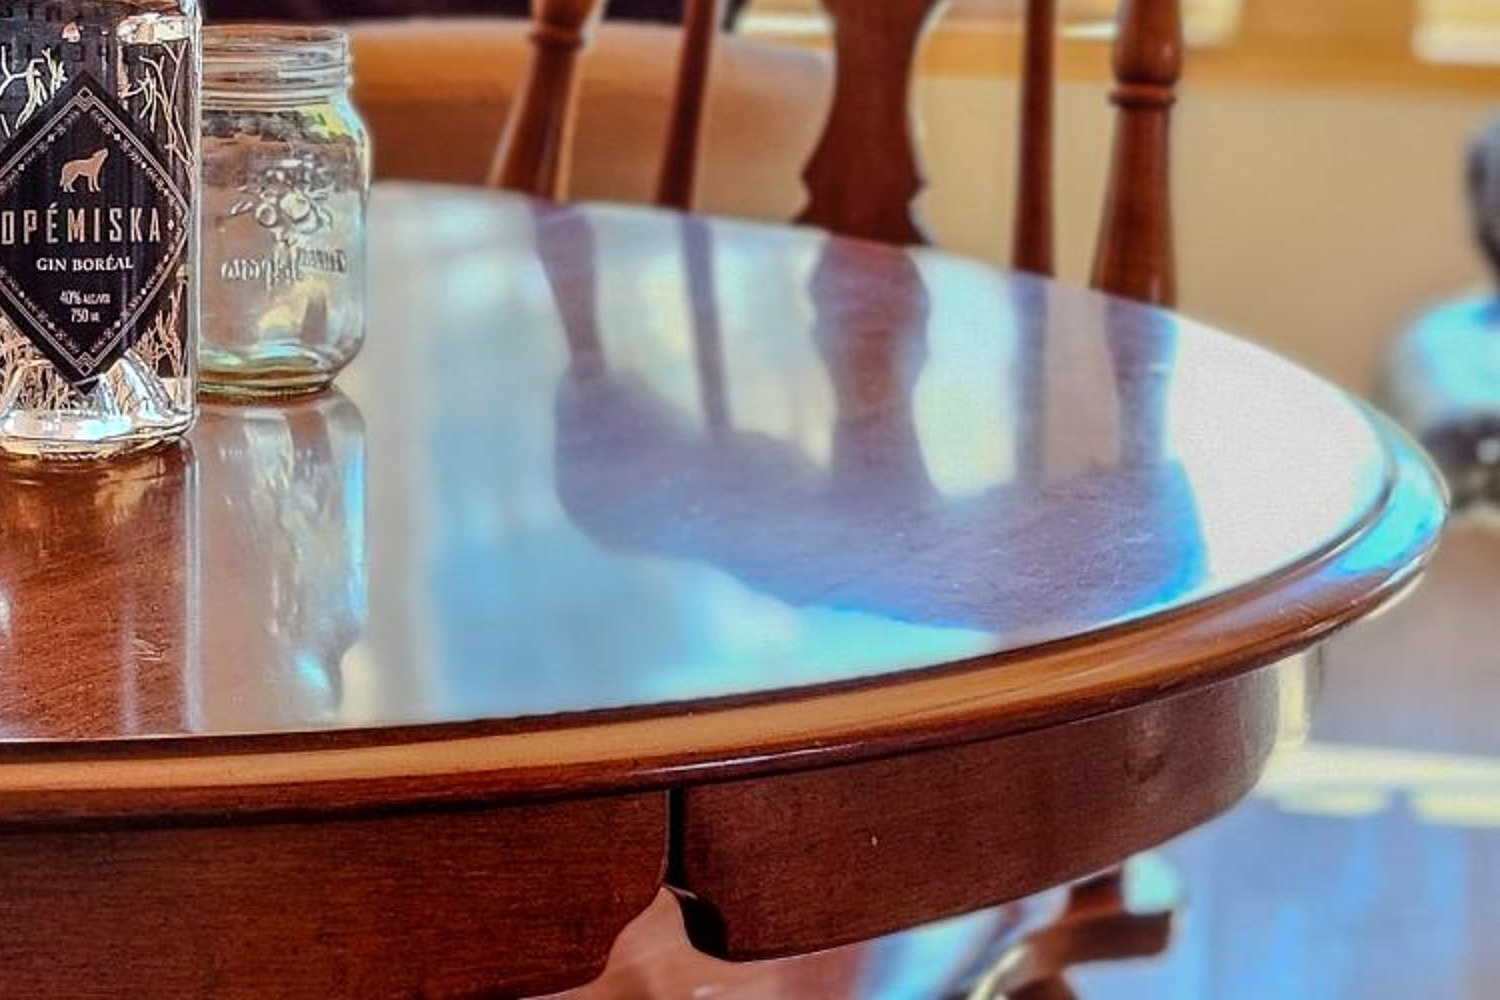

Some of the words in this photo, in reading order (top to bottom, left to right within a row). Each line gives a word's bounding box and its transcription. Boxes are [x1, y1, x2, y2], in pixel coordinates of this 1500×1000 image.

[1, 202, 161, 246] OPÉMISKA
[35, 256, 67, 272] GIN
[72, 253, 133, 272] BORÉAL
[70, 307, 89, 323] 750
